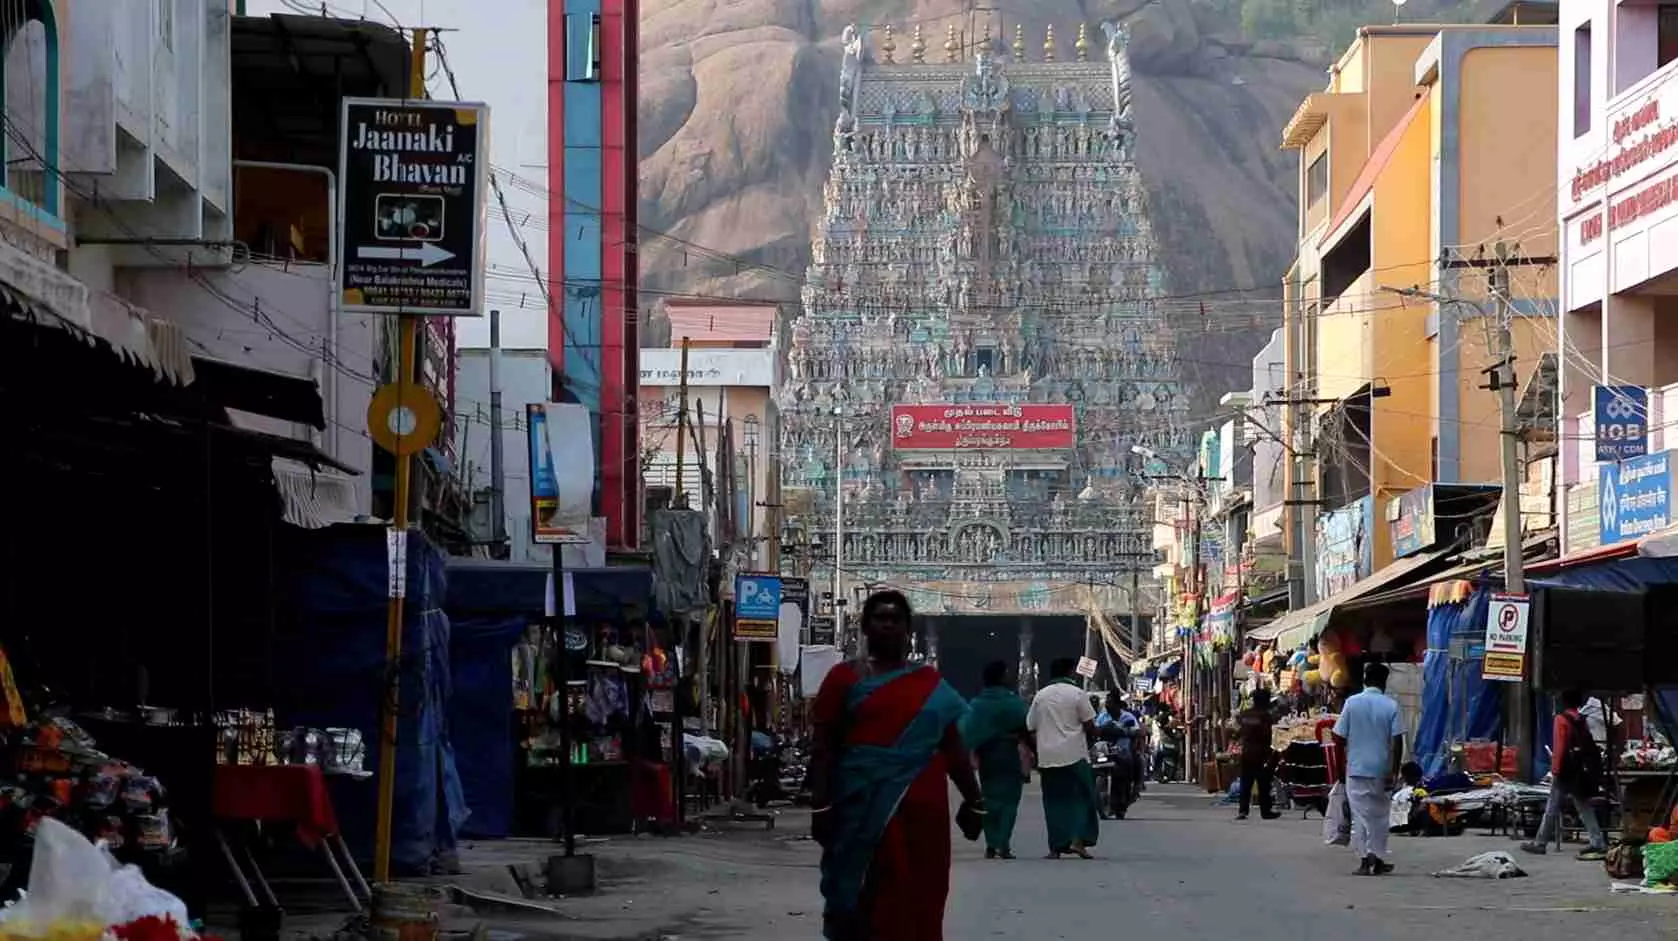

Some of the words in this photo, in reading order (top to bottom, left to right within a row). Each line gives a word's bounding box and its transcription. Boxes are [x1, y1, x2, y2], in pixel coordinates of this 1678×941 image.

[353, 122, 455, 153] Jaanaki
[373, 154, 466, 185] Bhavan
[944, 405, 974, 418] முதல்
[976, 407, 1000, 417] படை
[1600, 424, 1641, 441] IOB
[1489, 633, 1498, 641] NO
[1499, 633, 1523, 642] PARKING
